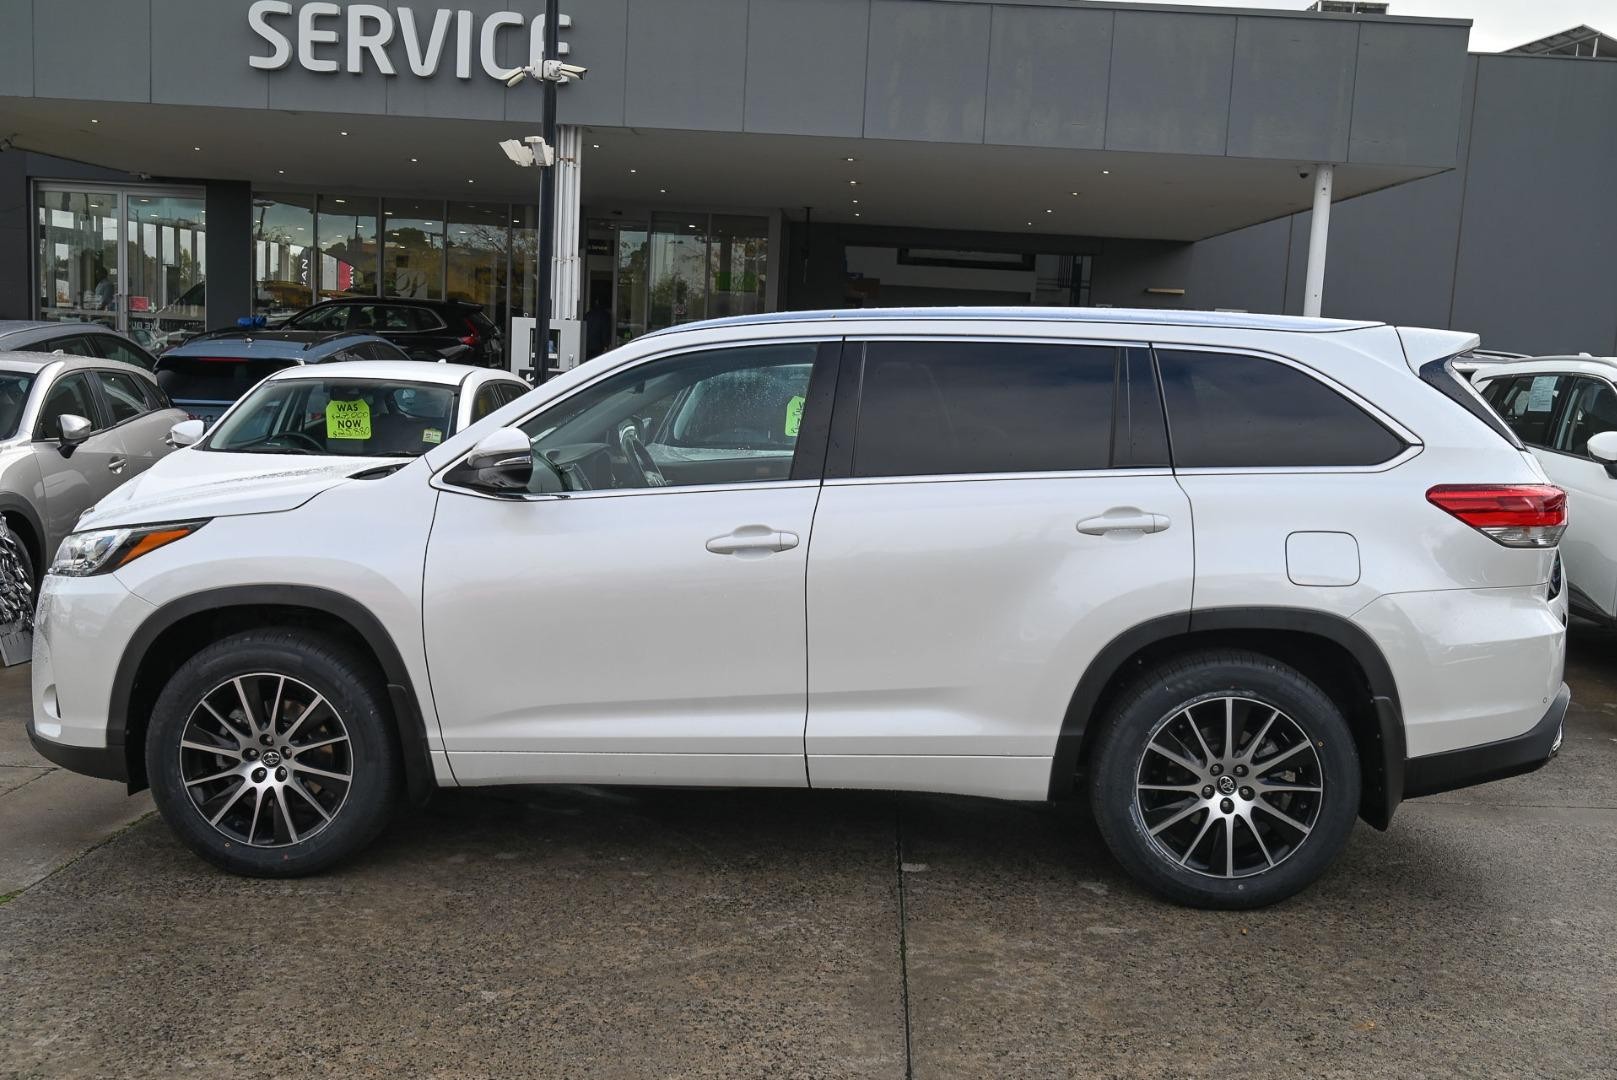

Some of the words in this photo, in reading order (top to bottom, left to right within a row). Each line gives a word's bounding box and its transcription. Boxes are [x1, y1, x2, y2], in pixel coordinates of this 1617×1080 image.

[248, 0, 572, 83] SERVICE
[337, 403, 358, 412] WAS
[337, 419, 361, 429] NOW
